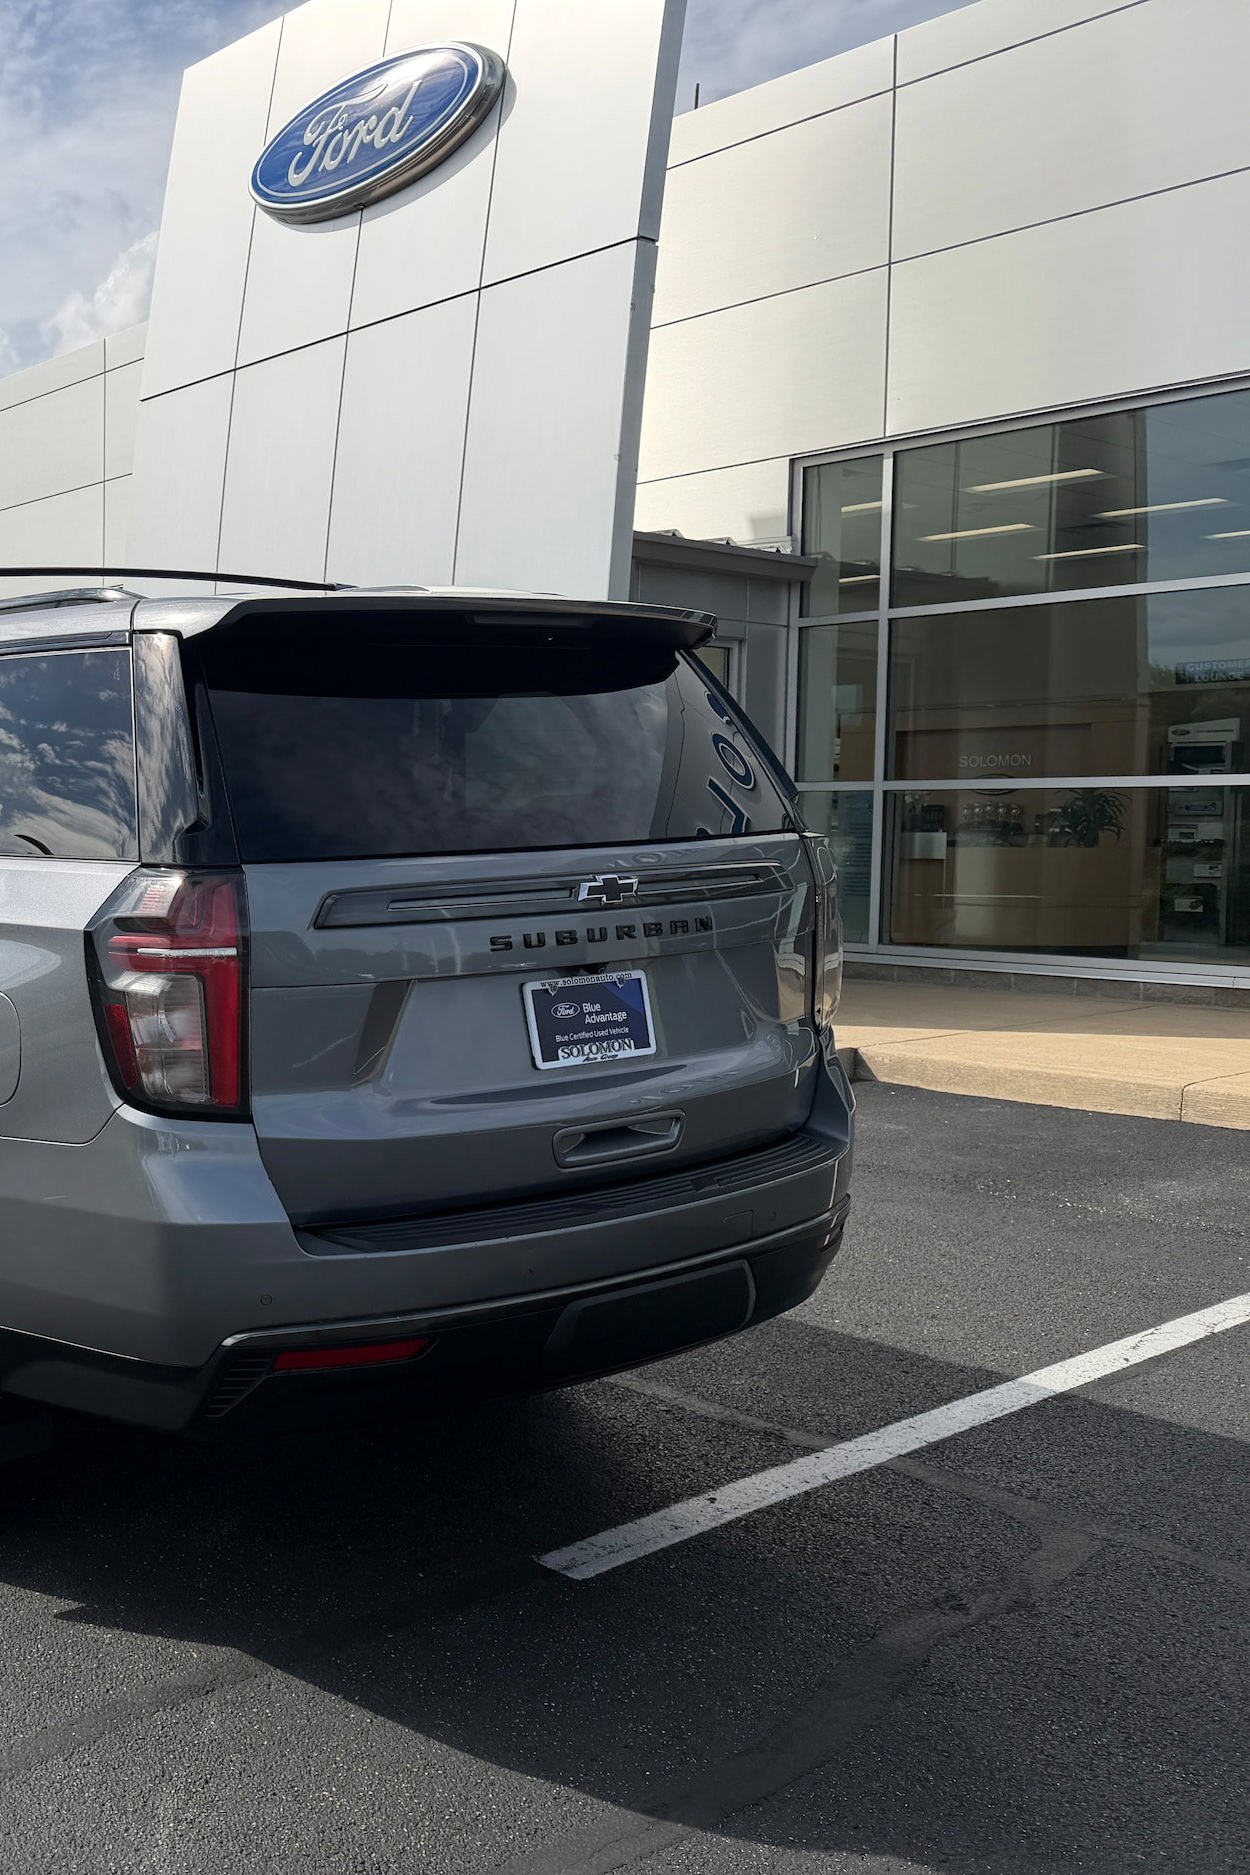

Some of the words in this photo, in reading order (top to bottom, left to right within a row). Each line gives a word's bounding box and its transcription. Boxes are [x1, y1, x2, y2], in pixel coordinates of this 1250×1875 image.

[288, 80, 423, 187] Ford
[1194, 671, 1245, 682] LOUNGE
[959, 754, 1032, 768] SOLOMON
[489, 916, 713, 952] SUBURBAN
[540, 972, 632, 988] www.solomonauto.com
[556, 1004, 574, 1016] Ford
[582, 1002, 601, 1013] Blue
[584, 1010, 628, 1024] Advantage
[555, 1034, 569, 1042] Blue
[570, 1030, 593, 1041] Certified
[594, 1028, 609, 1038] Used
[609, 1026, 630, 1035] Vehicle
[561, 1038, 633, 1059] SOLOMON
